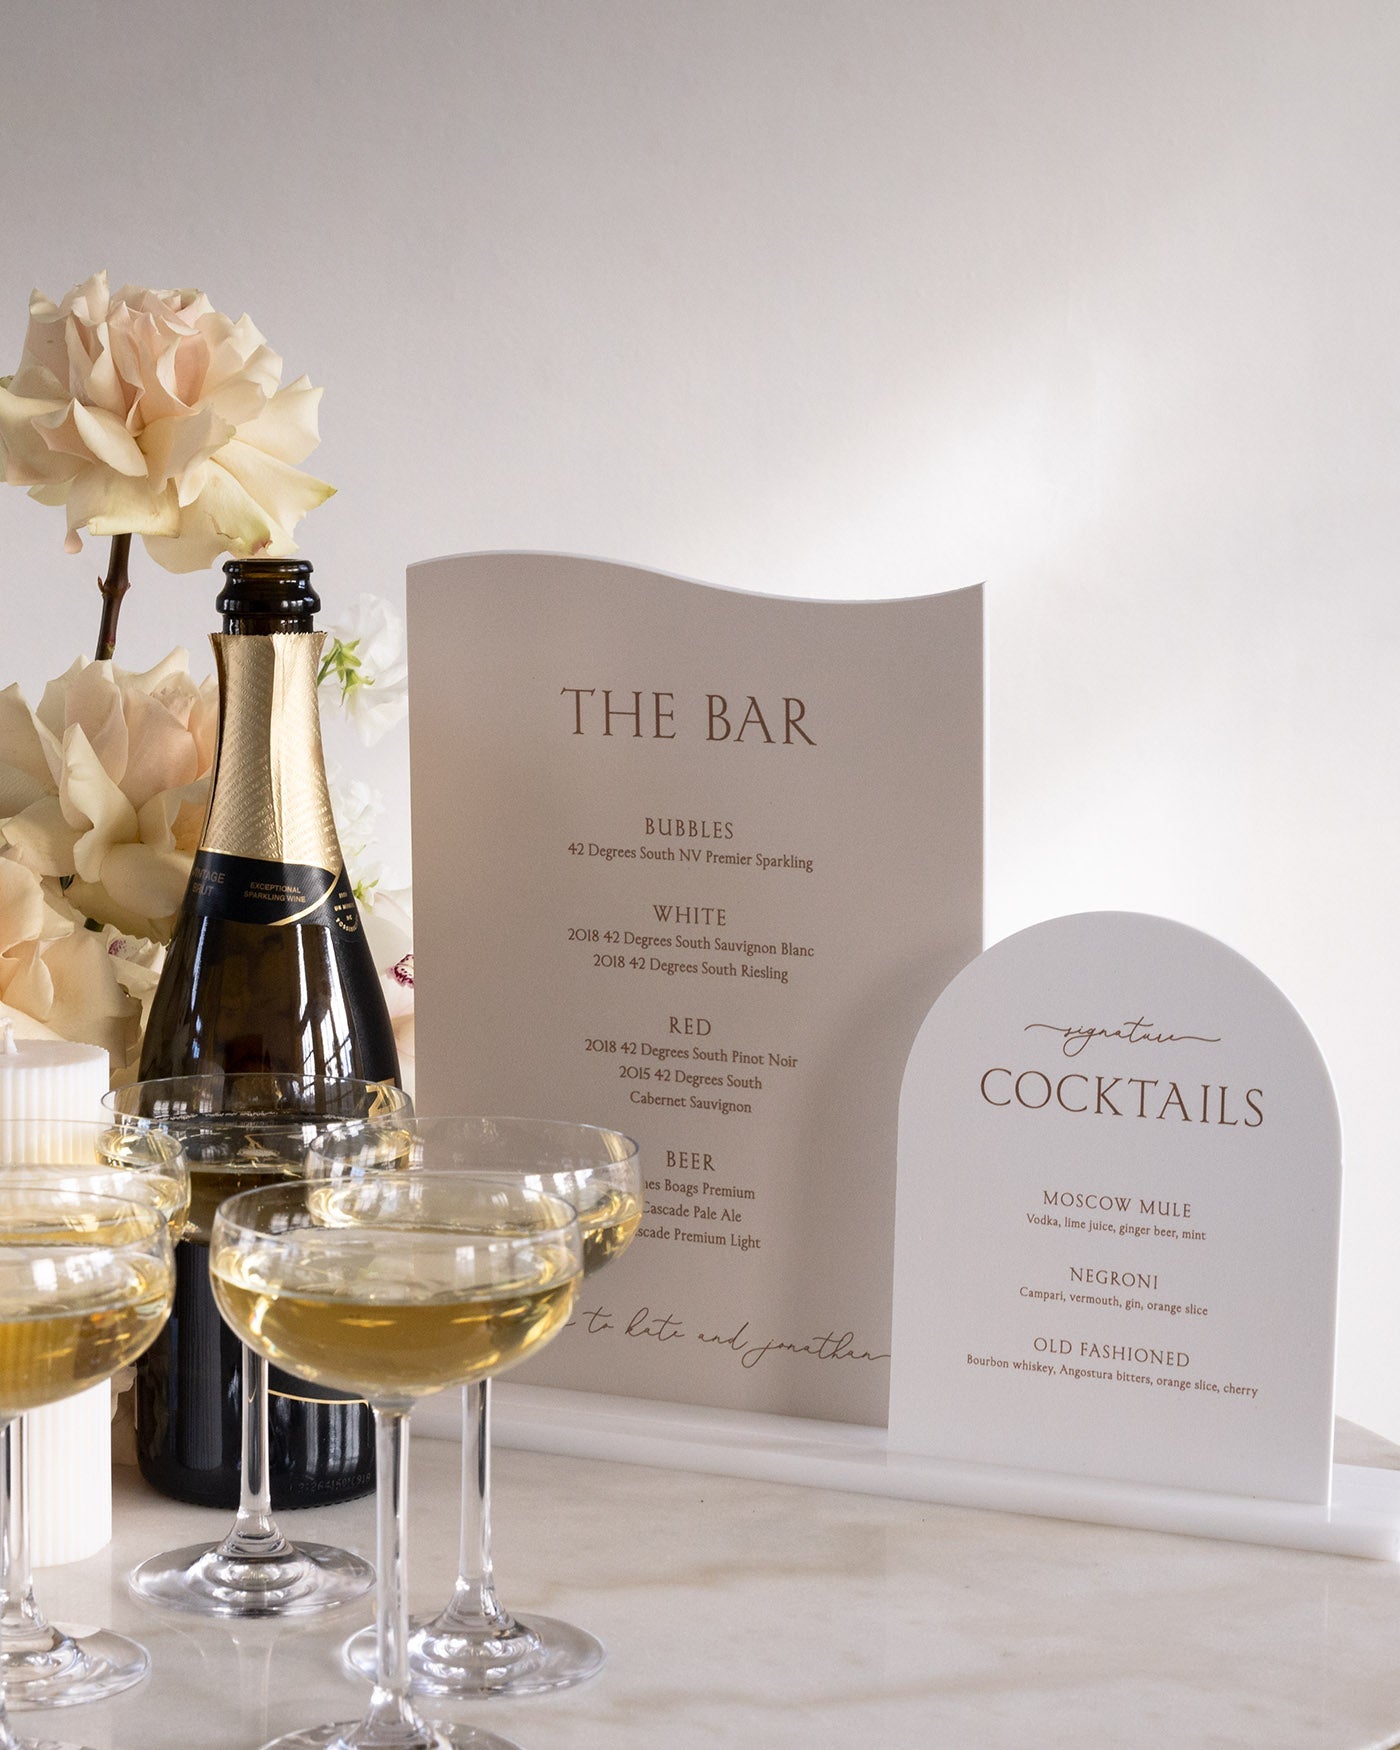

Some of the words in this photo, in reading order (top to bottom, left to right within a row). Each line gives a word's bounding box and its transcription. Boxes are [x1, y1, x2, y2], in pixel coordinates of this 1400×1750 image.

[561, 687, 676, 739] THE
[706, 694, 817, 745] BAR
[645, 817, 733, 839] BUBBLES
[568, 843, 584, 855] 42
[588, 843, 636, 861] Degrees
[640, 846, 675, 861] South
[679, 848, 702, 862] NV
[706, 850, 752, 865] Premier
[756, 853, 813, 873] Sparkling
[243, 890, 286, 902] SPARKLING
[286, 895, 307, 903] WINE
[250, 881, 301, 894] EXCEPTIONAL
[653, 905, 726, 926] WHITE
[568, 928, 599, 942] 2018
[603, 931, 620, 943] 42
[624, 931, 672, 949] Degrees
[676, 935, 711, 950] South
[715, 938, 776, 957] Sauvignon
[781, 942, 814, 957] Blanc
[593, 954, 625, 968] 2018
[629, 957, 645, 970] 42
[650, 958, 698, 976] Degrees
[702, 961, 737, 976] South
[741, 964, 788, 984] Riesling
[670, 1016, 711, 1036] RED
[1024, 1016, 1221, 1057] signature
[585, 1039, 617, 1053] 2018
[620, 1042, 637, 1055] 42
[641, 1043, 689, 1061] Degrees
[693, 1047, 728, 1062] South
[732, 1050, 764, 1065] Pinot
[768, 1053, 798, 1067] Noir
[619, 1065, 650, 1080] 2015
[654, 1069, 671, 1082] 42
[675, 1070, 723, 1088] Degrees
[727, 1074, 762, 1089] South
[630, 1091, 686, 1107] Cabernet
[690, 1096, 752, 1115] Sauvignon
[981, 1068, 1263, 1127] COCKTAILS
[667, 1150, 715, 1171] BEER
[665, 1179, 698, 1197] Boags
[703, 1182, 755, 1199] Premium
[694, 1206, 717, 1220] Pale
[721, 1209, 741, 1222] Ale
[1044, 1190, 1131, 1211] MOSCOW
[1140, 1199, 1190, 1218] MULE
[636, 1226, 671, 1240] scade
[674, 1228, 726, 1245] Premium
[731, 1234, 760, 1251] Light
[1027, 1213, 1061, 1228] Vodka,
[1065, 1217, 1086, 1229] lime
[1088, 1220, 1116, 1233] juice,
[1119, 1223, 1151, 1239] ginger
[1154, 1225, 1178, 1239] beer,
[1181, 1229, 1206, 1241] mint
[1070, 1267, 1159, 1290] NEGRONI
[1020, 1286, 1066, 1302] Campari,
[1069, 1294, 1122, 1308] vermouth,
[1125, 1299, 1143, 1311] gin,
[1147, 1302, 1181, 1315] orange
[1185, 1303, 1208, 1316] slice
[582, 1306, 614, 1334] to
[625, 1307, 685, 1341] kate
[698, 1322, 748, 1351] and
[741, 1332, 892, 1369] jonathan
[1034, 1337, 1072, 1354] OLD
[1081, 1342, 1189, 1367] FASHIONED
[967, 1354, 1009, 1368] Bourbon
[1013, 1360, 1056, 1376] whiskey,
[1059, 1364, 1113, 1380] Angostura
[1116, 1370, 1153, 1386] bitters,
[1156, 1378, 1191, 1391] orange
[1194, 1379, 1220, 1393] slice,
[1223, 1383, 1258, 1399] cherry
